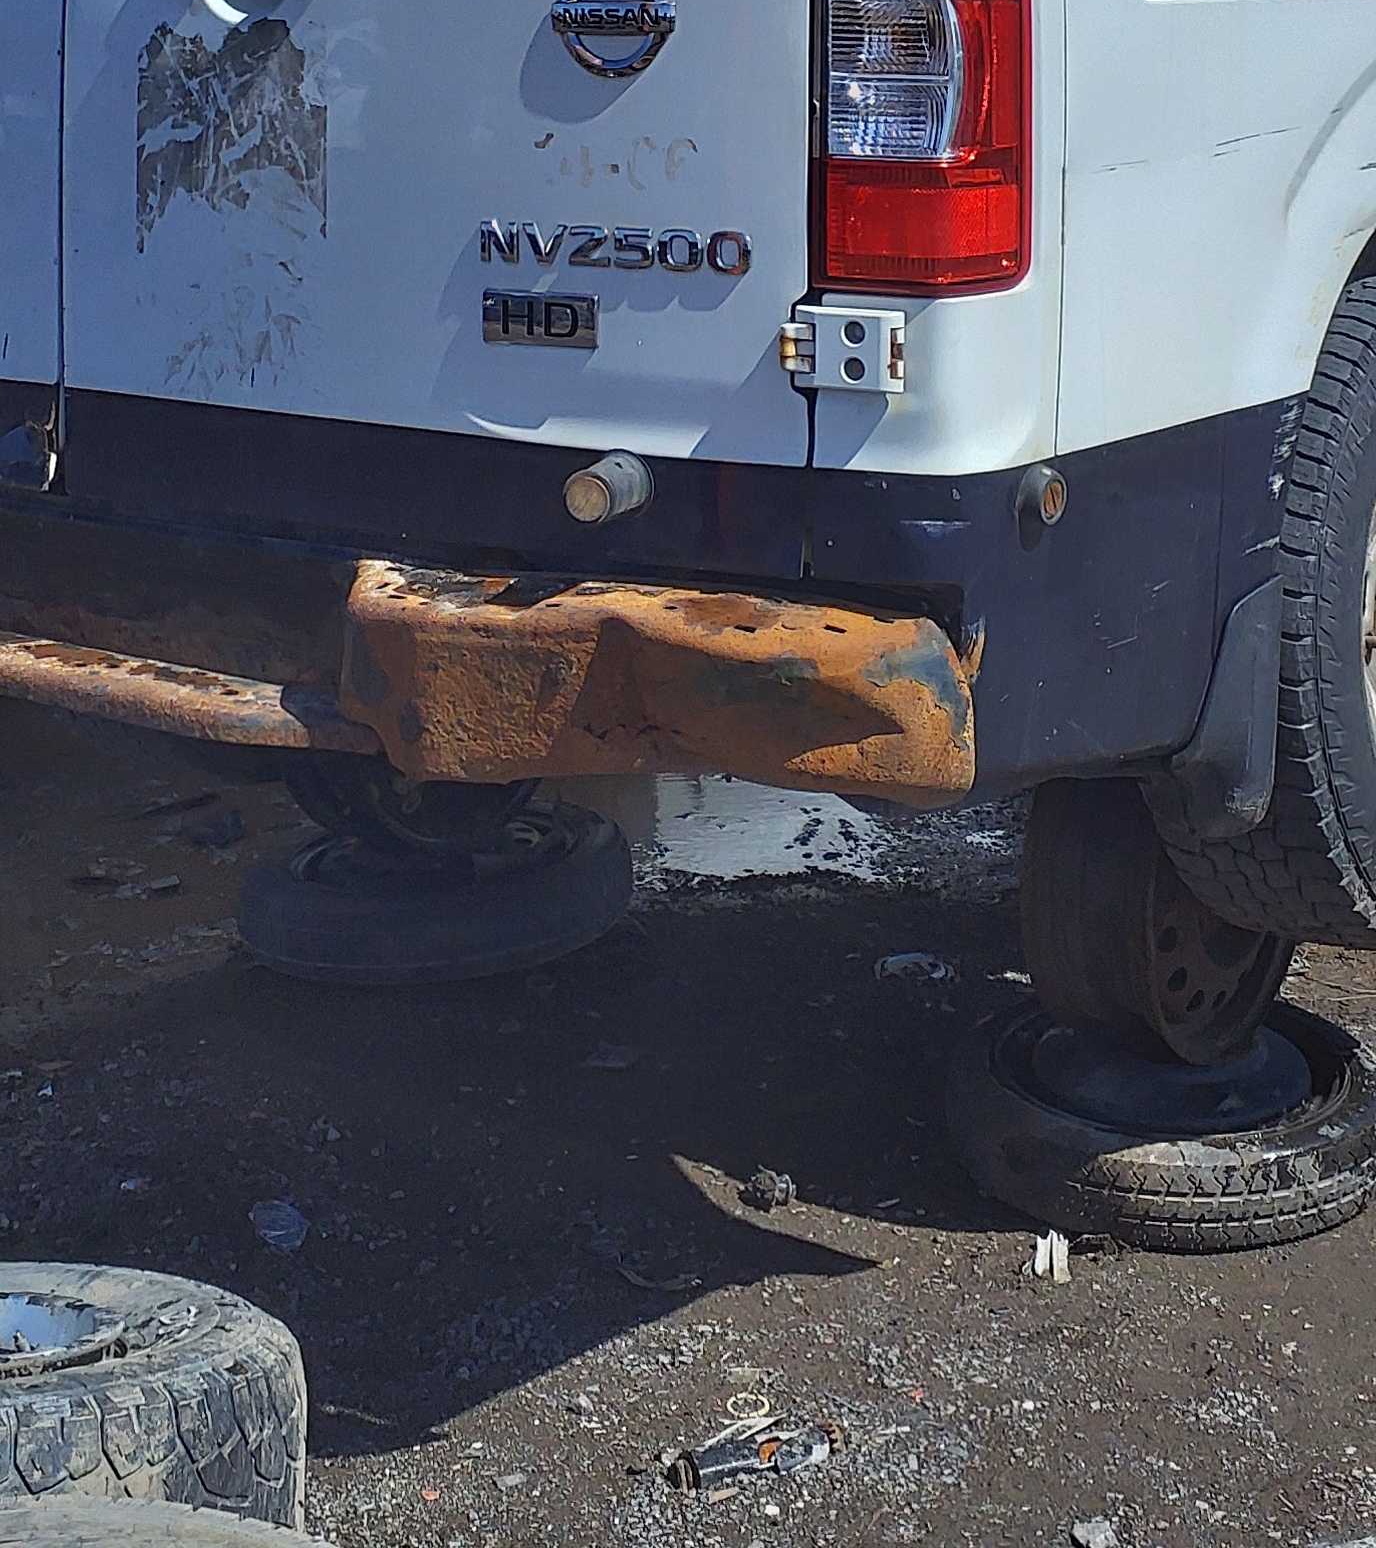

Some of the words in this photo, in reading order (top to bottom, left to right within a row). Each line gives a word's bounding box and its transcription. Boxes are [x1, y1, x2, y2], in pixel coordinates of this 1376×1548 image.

[562, 4, 661, 28] NISSAN
[479, 219, 752, 276] NV2500
[499, 298, 579, 340] HD
